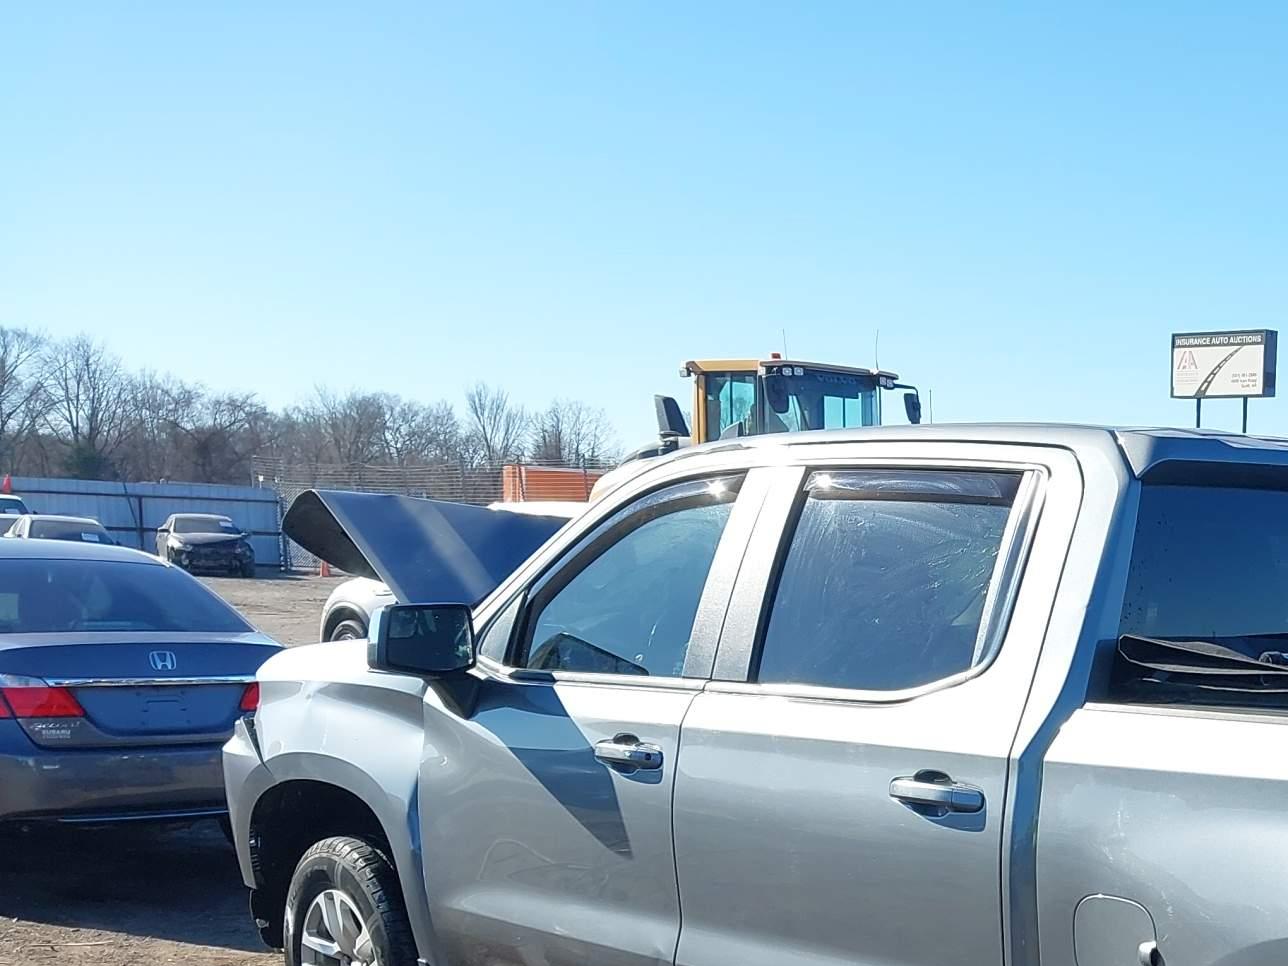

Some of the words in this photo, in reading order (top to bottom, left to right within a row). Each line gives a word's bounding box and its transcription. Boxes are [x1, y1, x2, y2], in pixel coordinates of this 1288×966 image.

[1175, 336, 1211, 346] INSURANCE
[1211, 336, 1228, 345] AUTO
[1229, 335, 1262, 344] AUCTIONS
